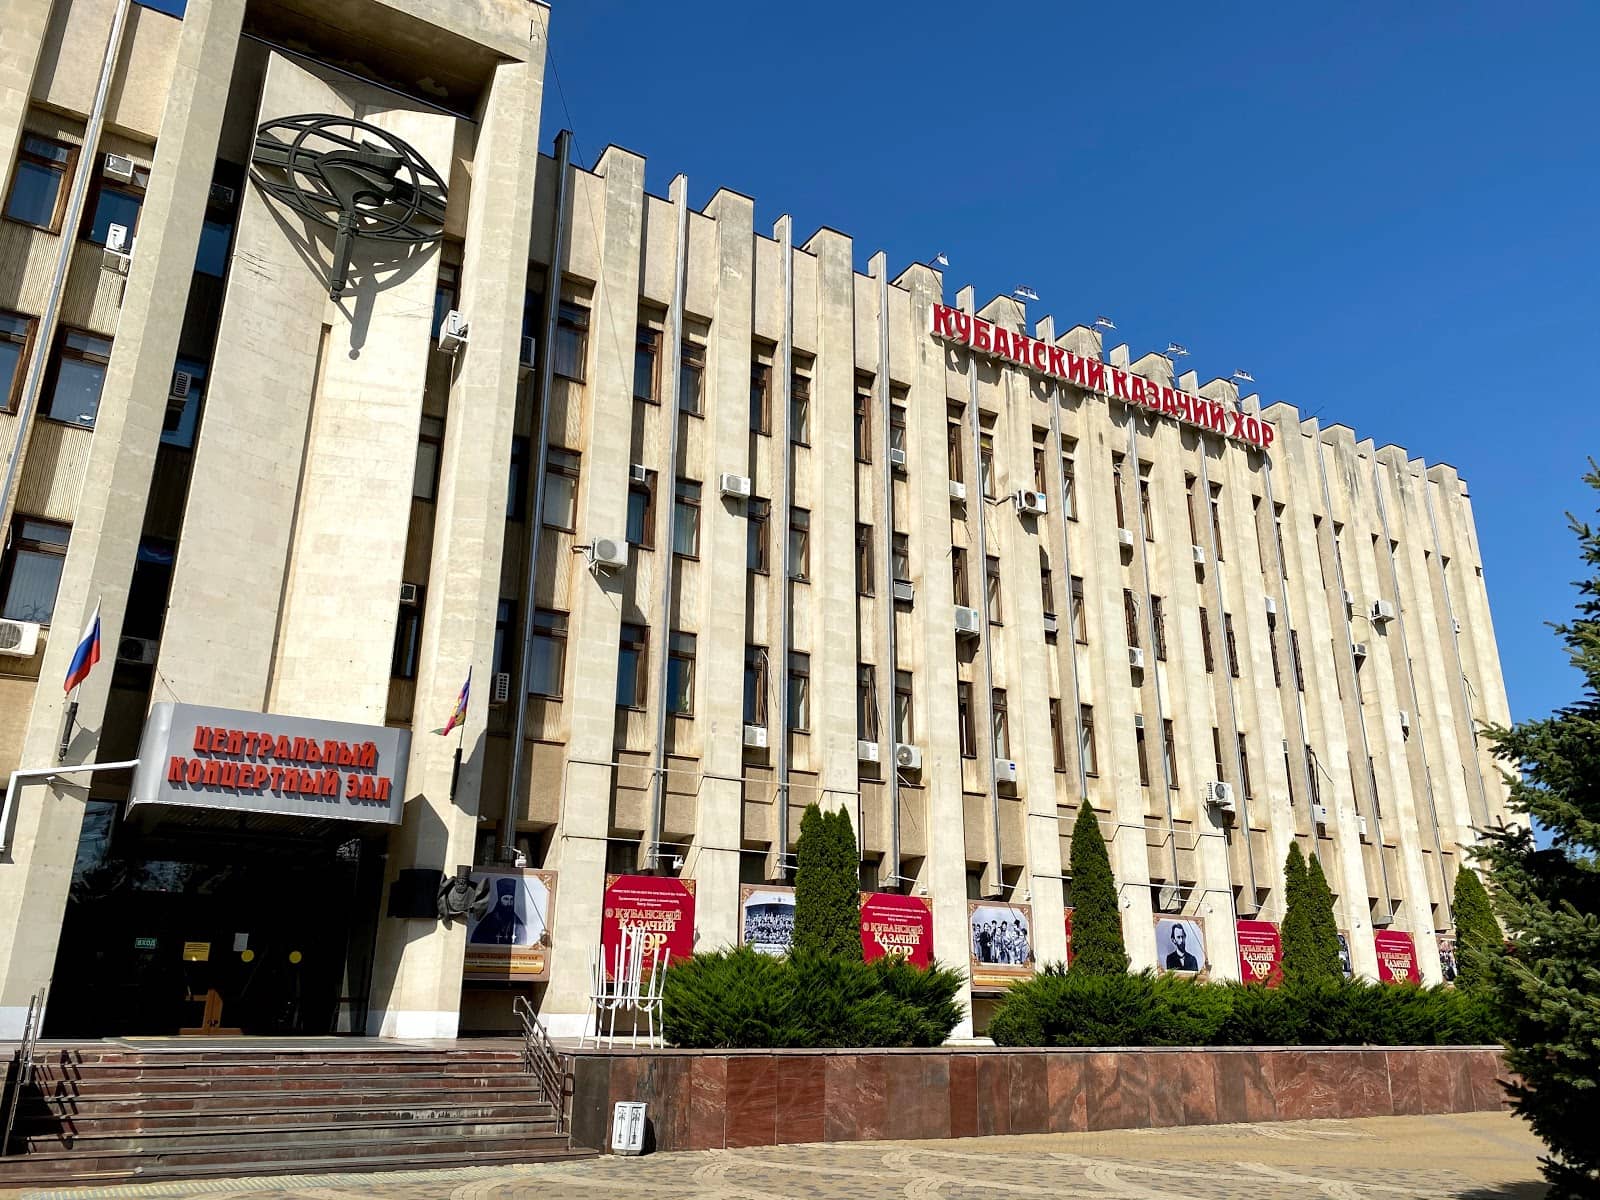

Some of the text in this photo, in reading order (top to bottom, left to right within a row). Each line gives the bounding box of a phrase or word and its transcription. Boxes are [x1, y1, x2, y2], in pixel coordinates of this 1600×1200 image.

[933, 302, 1274, 449] КУБАНСКИЙ КАЗАЧИЙ ХОР
[193, 725, 377, 768] ЦЕНТРАЛЬНЫЙ
[168, 756, 391, 801] КОНЦЕРТНЫЙ ЗАЛ
[615, 907, 682, 921] КУБАНСКИЙ
[618, 917, 676, 932] КАЗАЧИЙ
[874, 930, 920, 945] КАЗАЧИЙ
[1248, 960, 1271, 979] ХОР
